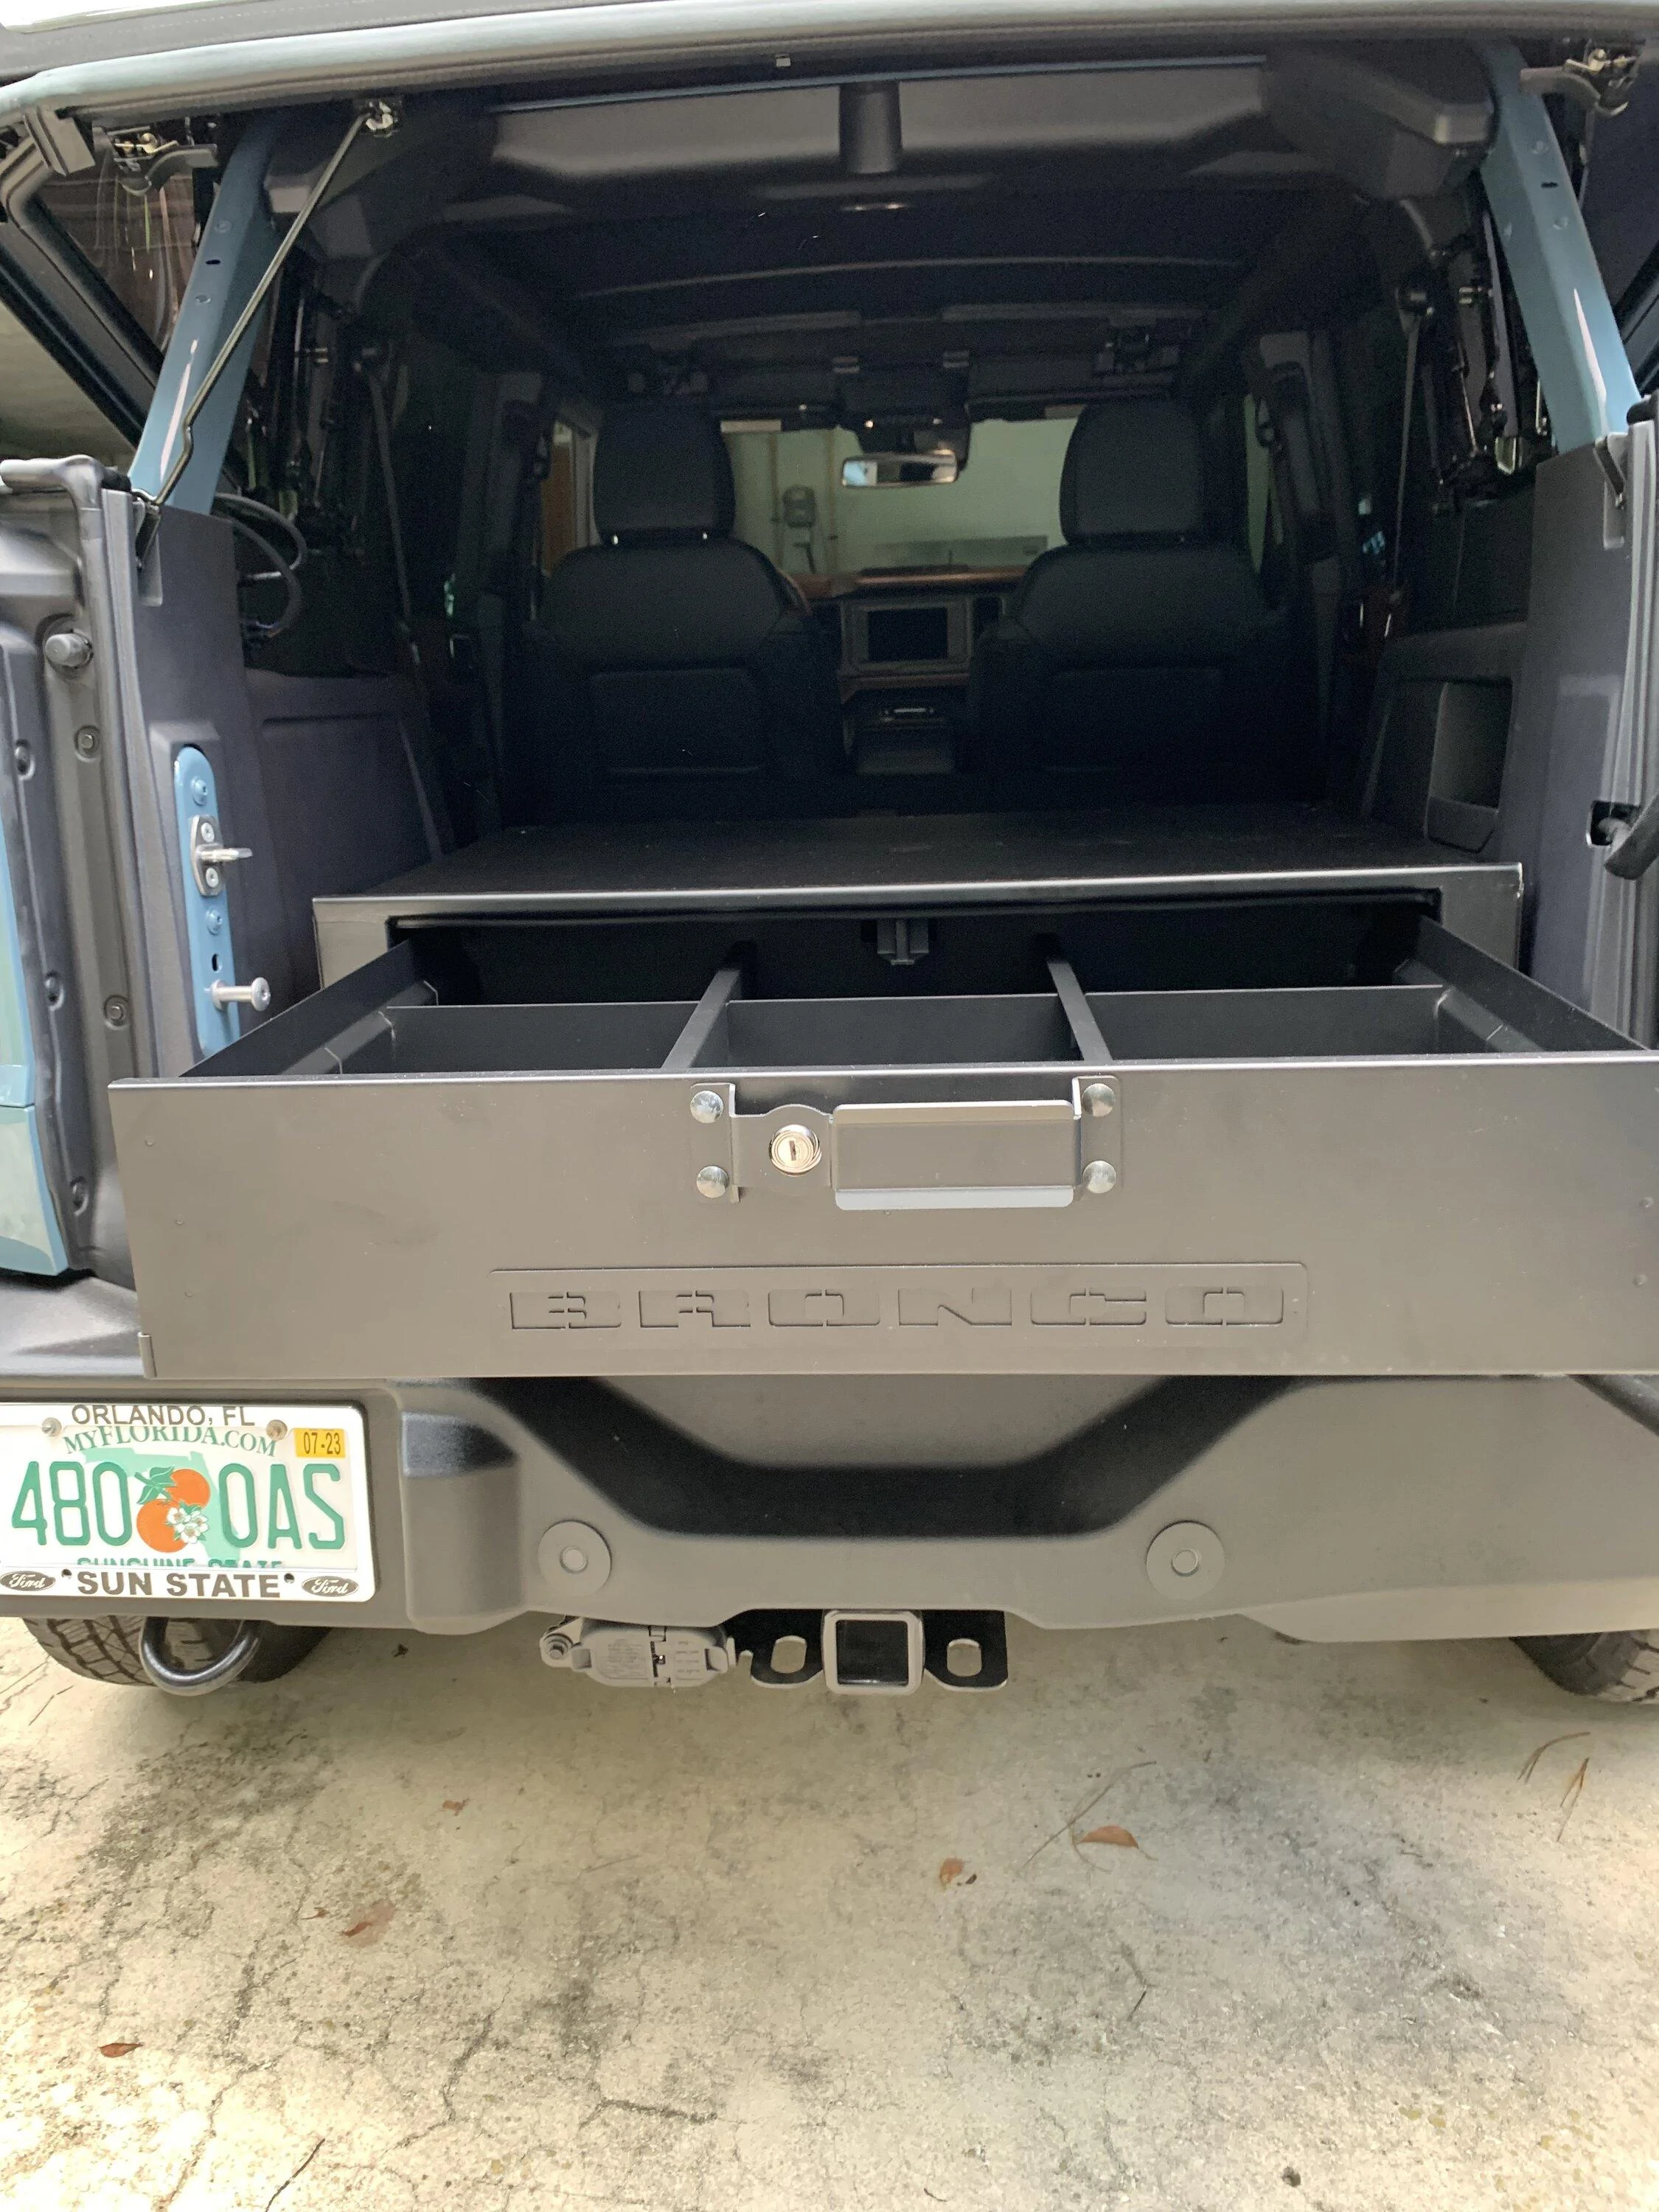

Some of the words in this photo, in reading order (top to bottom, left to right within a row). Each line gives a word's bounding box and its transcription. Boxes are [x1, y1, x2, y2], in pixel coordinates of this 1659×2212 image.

[510, 1287, 1284, 1329] BRONCO
[72, 1404, 213, 1427] ORLANDO,
[223, 1405, 255, 1426] FL
[12, 1461, 132, 1546] 480
[7, 1573, 46, 1589] Ford
[77, 1571, 153, 1595] SUN
[167, 1573, 280, 1598] STATE
[310, 1578, 349, 1594] Ford
